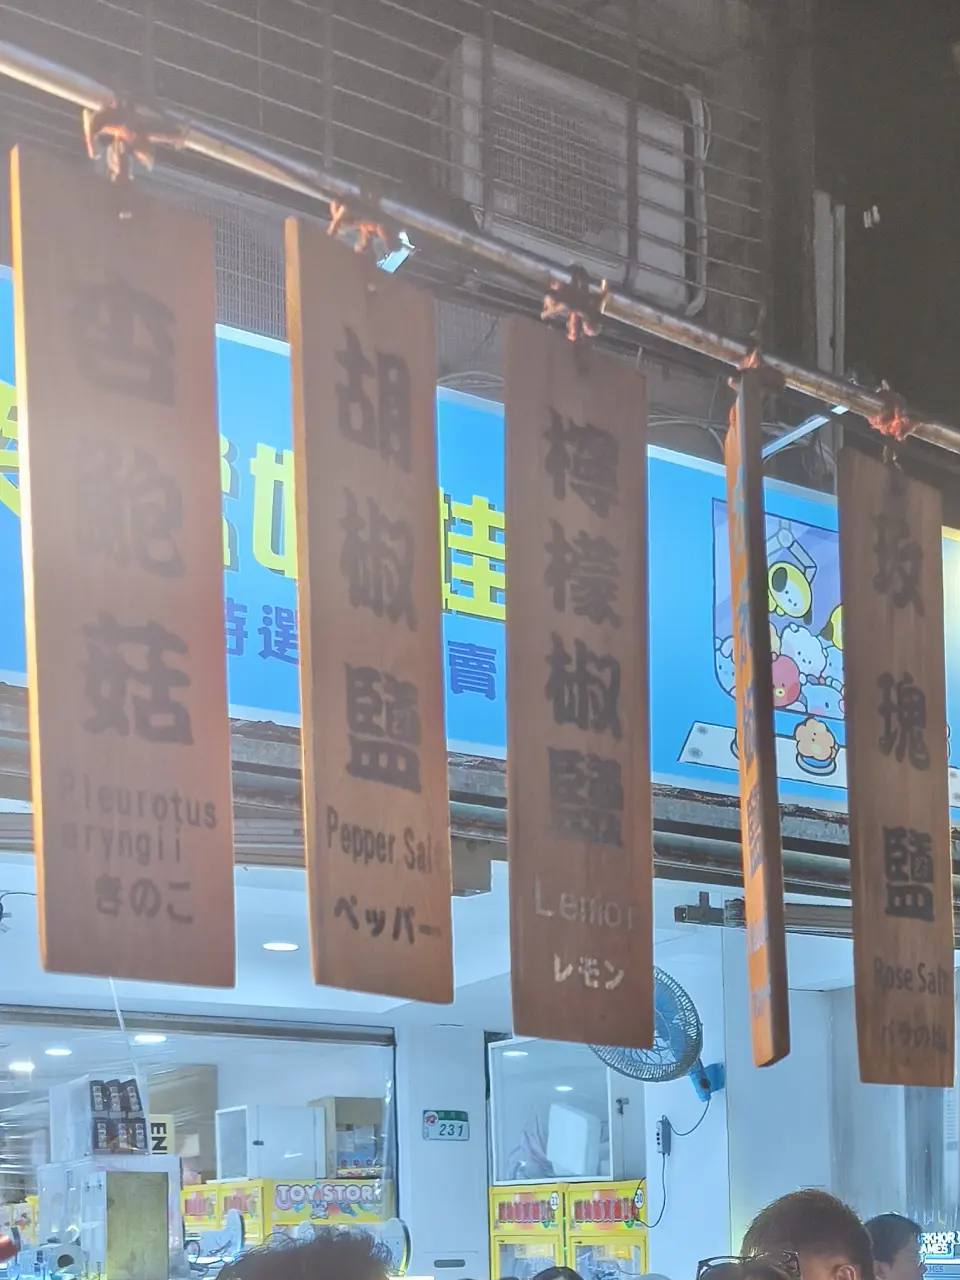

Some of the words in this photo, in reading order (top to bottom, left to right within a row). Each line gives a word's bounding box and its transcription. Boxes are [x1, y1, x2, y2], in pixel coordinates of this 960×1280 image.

[334, 325, 423, 793] 胡椒鹽
[872, 510, 936, 923] 玫瑰鹽
[326, 804, 396, 865] Pepper
[553, 952, 626, 990] レモン
[438, 1123, 464, 1137] 231
[275, 1184, 316, 1203] TOY
